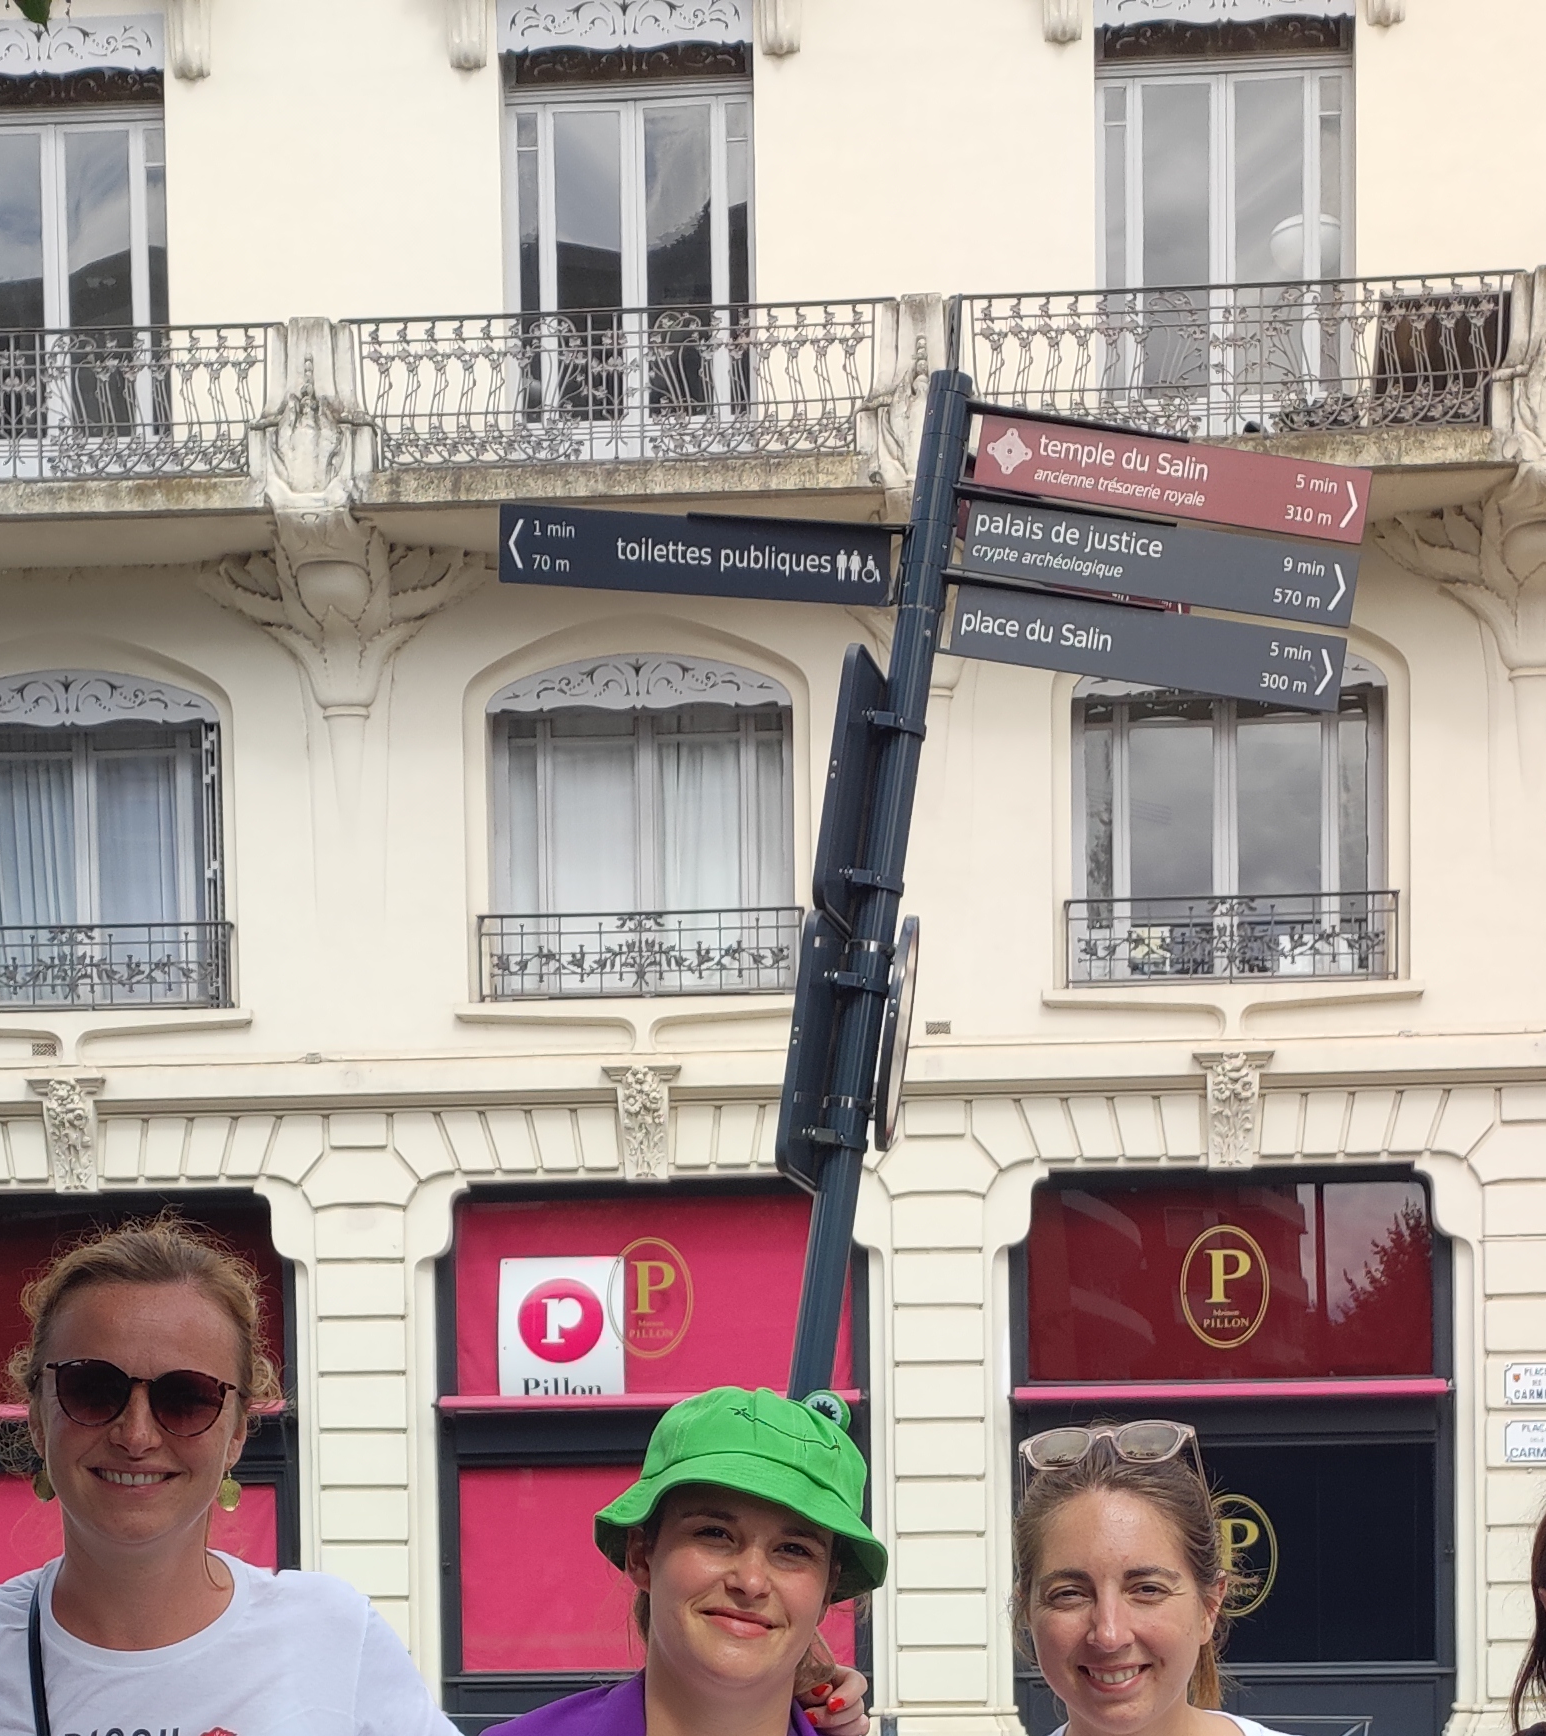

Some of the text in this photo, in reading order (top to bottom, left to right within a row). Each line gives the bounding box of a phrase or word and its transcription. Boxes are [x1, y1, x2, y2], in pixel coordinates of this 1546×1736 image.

[1039, 433, 1209, 482] temple du Salin
[1034, 467, 1205, 507] ancienne trésorerie royale
[1295, 474, 1337, 494] 5 min
[1284, 505, 1332, 525] 310 m
[533, 519, 575, 539] 1 min
[975, 512, 1163, 558] palais de justice
[532, 554, 570, 573] 70 m
[616, 537, 831, 576] toilettes publiques
[971, 542, 1123, 579] crypte archéologique
[1284, 557, 1325, 577] 9 min
[1273, 588, 1320, 608] 570 m
[960, 610, 1112, 652] place du Salin
[1269, 641, 1312, 661] 5 min
[1260, 672, 1307, 693] 300 m
[1203, 1249, 1251, 1303] P
[630, 1260, 676, 1314] P
[1203, 1317, 1249, 1328] PILLON
[629, 1328, 674, 1339] PILLON
[522, 1377, 602, 1396] Pillon
